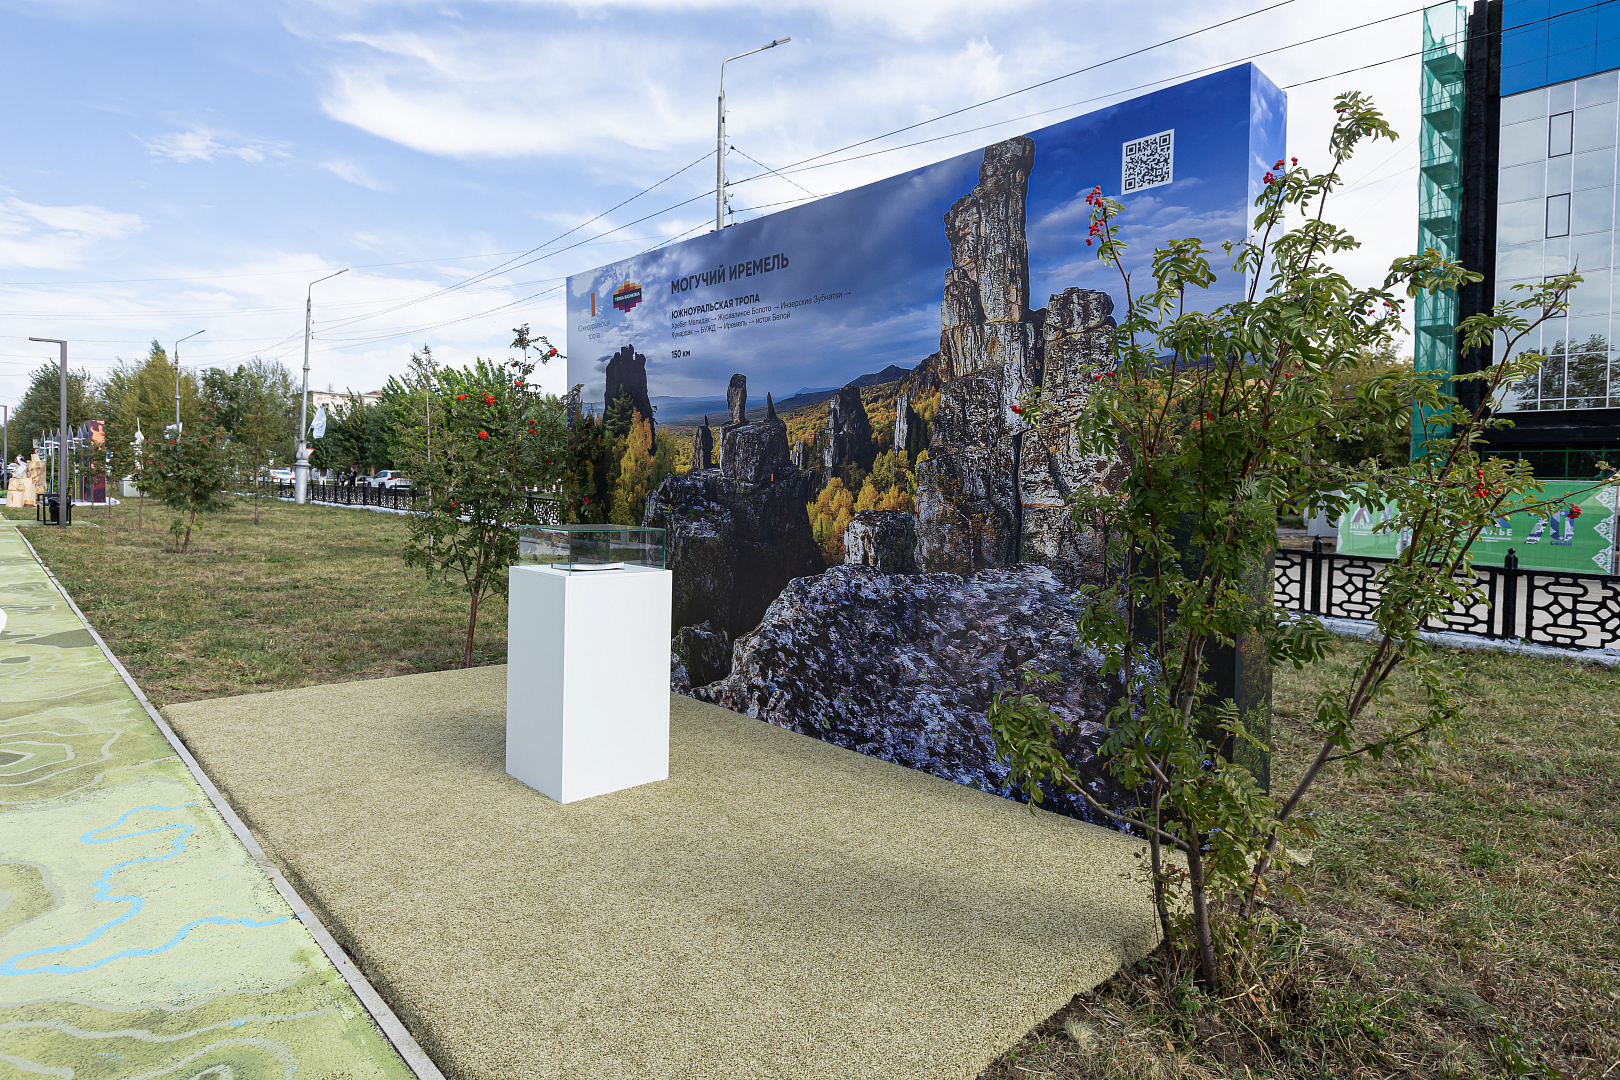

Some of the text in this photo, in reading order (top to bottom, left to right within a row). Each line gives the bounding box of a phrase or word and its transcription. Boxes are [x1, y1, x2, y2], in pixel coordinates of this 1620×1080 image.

[671, 253, 790, 295] МОГУЧИЙ ИРЕМЕЛЬ
[671, 293, 760, 319] ЮЖНОУРАЛЬСКАЯ ТРОПА
[751, 305, 772, 315] Болото
[780, 297, 813, 310] Инзерские
[813, 291, 843, 305] Зубчатки
[723, 319, 748, 331] Иремель
[755, 315, 772, 325] исток
[772, 311, 791, 322] Белой
[671, 349, 691, 359] 150 км
